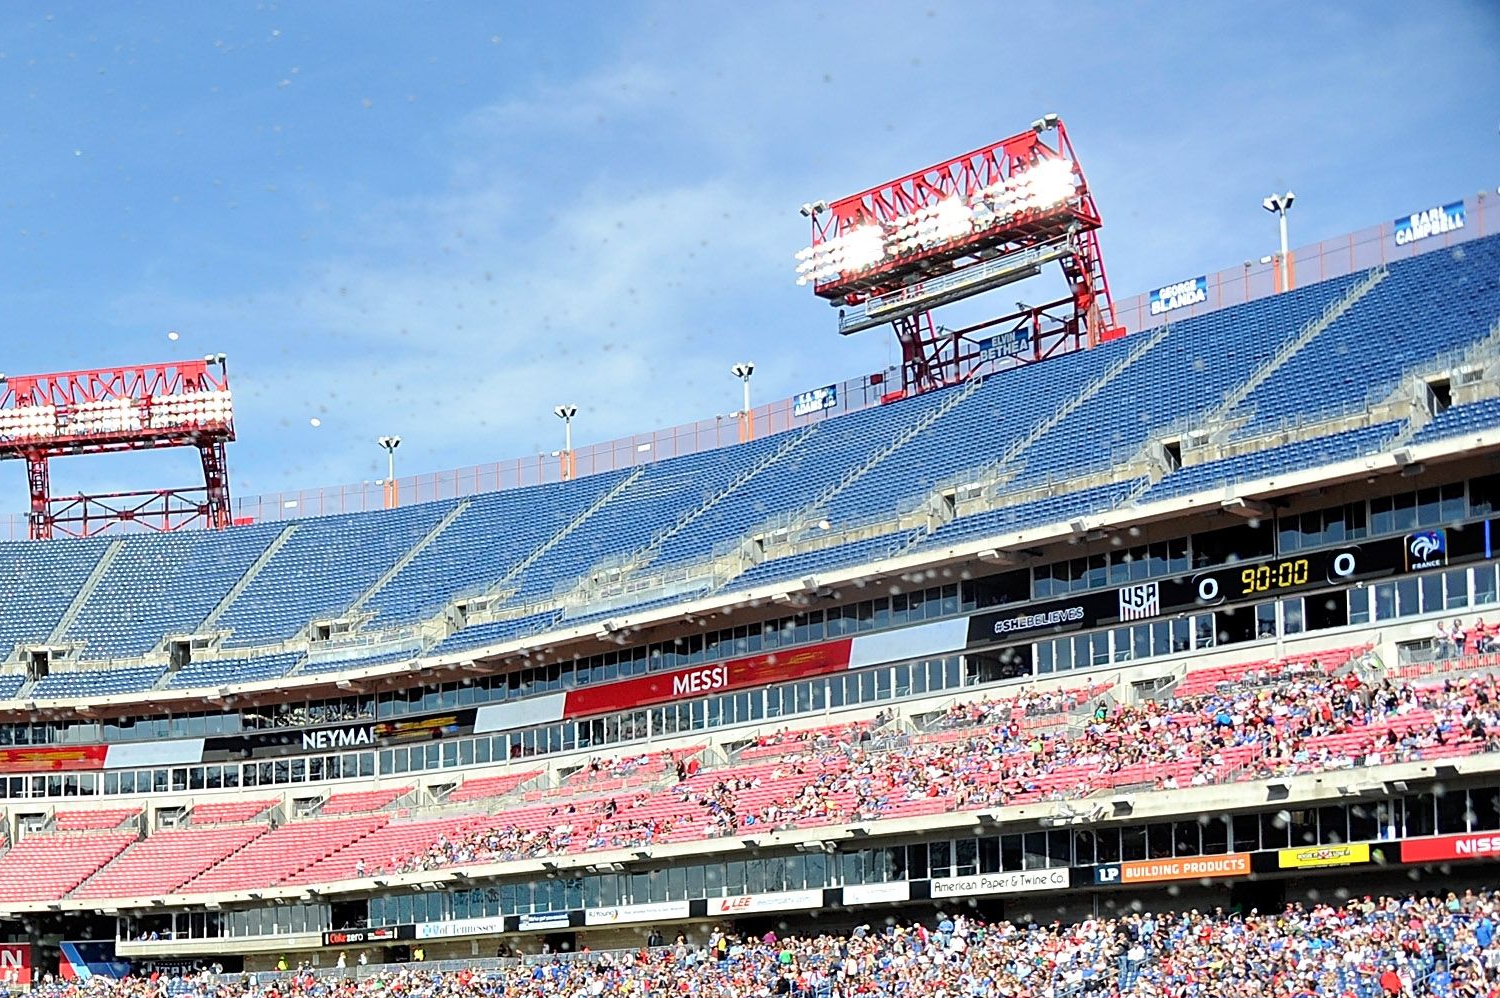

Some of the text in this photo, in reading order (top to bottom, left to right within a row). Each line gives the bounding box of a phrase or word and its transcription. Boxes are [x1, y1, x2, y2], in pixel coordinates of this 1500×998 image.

[1396, 213, 1464, 245] CAMPBELL
[1151, 288, 1205, 315] BLANDA
[980, 339, 1029, 362] BETHEA
[991, 331, 1016, 347] ELVIN
[1242, 559, 1309, 594] 90:00
[1412, 560, 1441, 571] FRANCE
[1122, 583, 1156, 608] USA
[995, 607, 1084, 633] #SHEBELIEVES
[673, 666, 728, 696] MESSI
[1099, 858, 1245, 881] LP BUILDING PRODUCTS
[935, 880, 977, 892] American
[981, 875, 1009, 891] Paper
[1020, 874, 1048, 887] Twine
[1050, 872, 1066, 884] Co.
[731, 897, 752, 907] LEE
[347, 932, 363, 943] zero
[439, 923, 497, 935] of Tennessee
